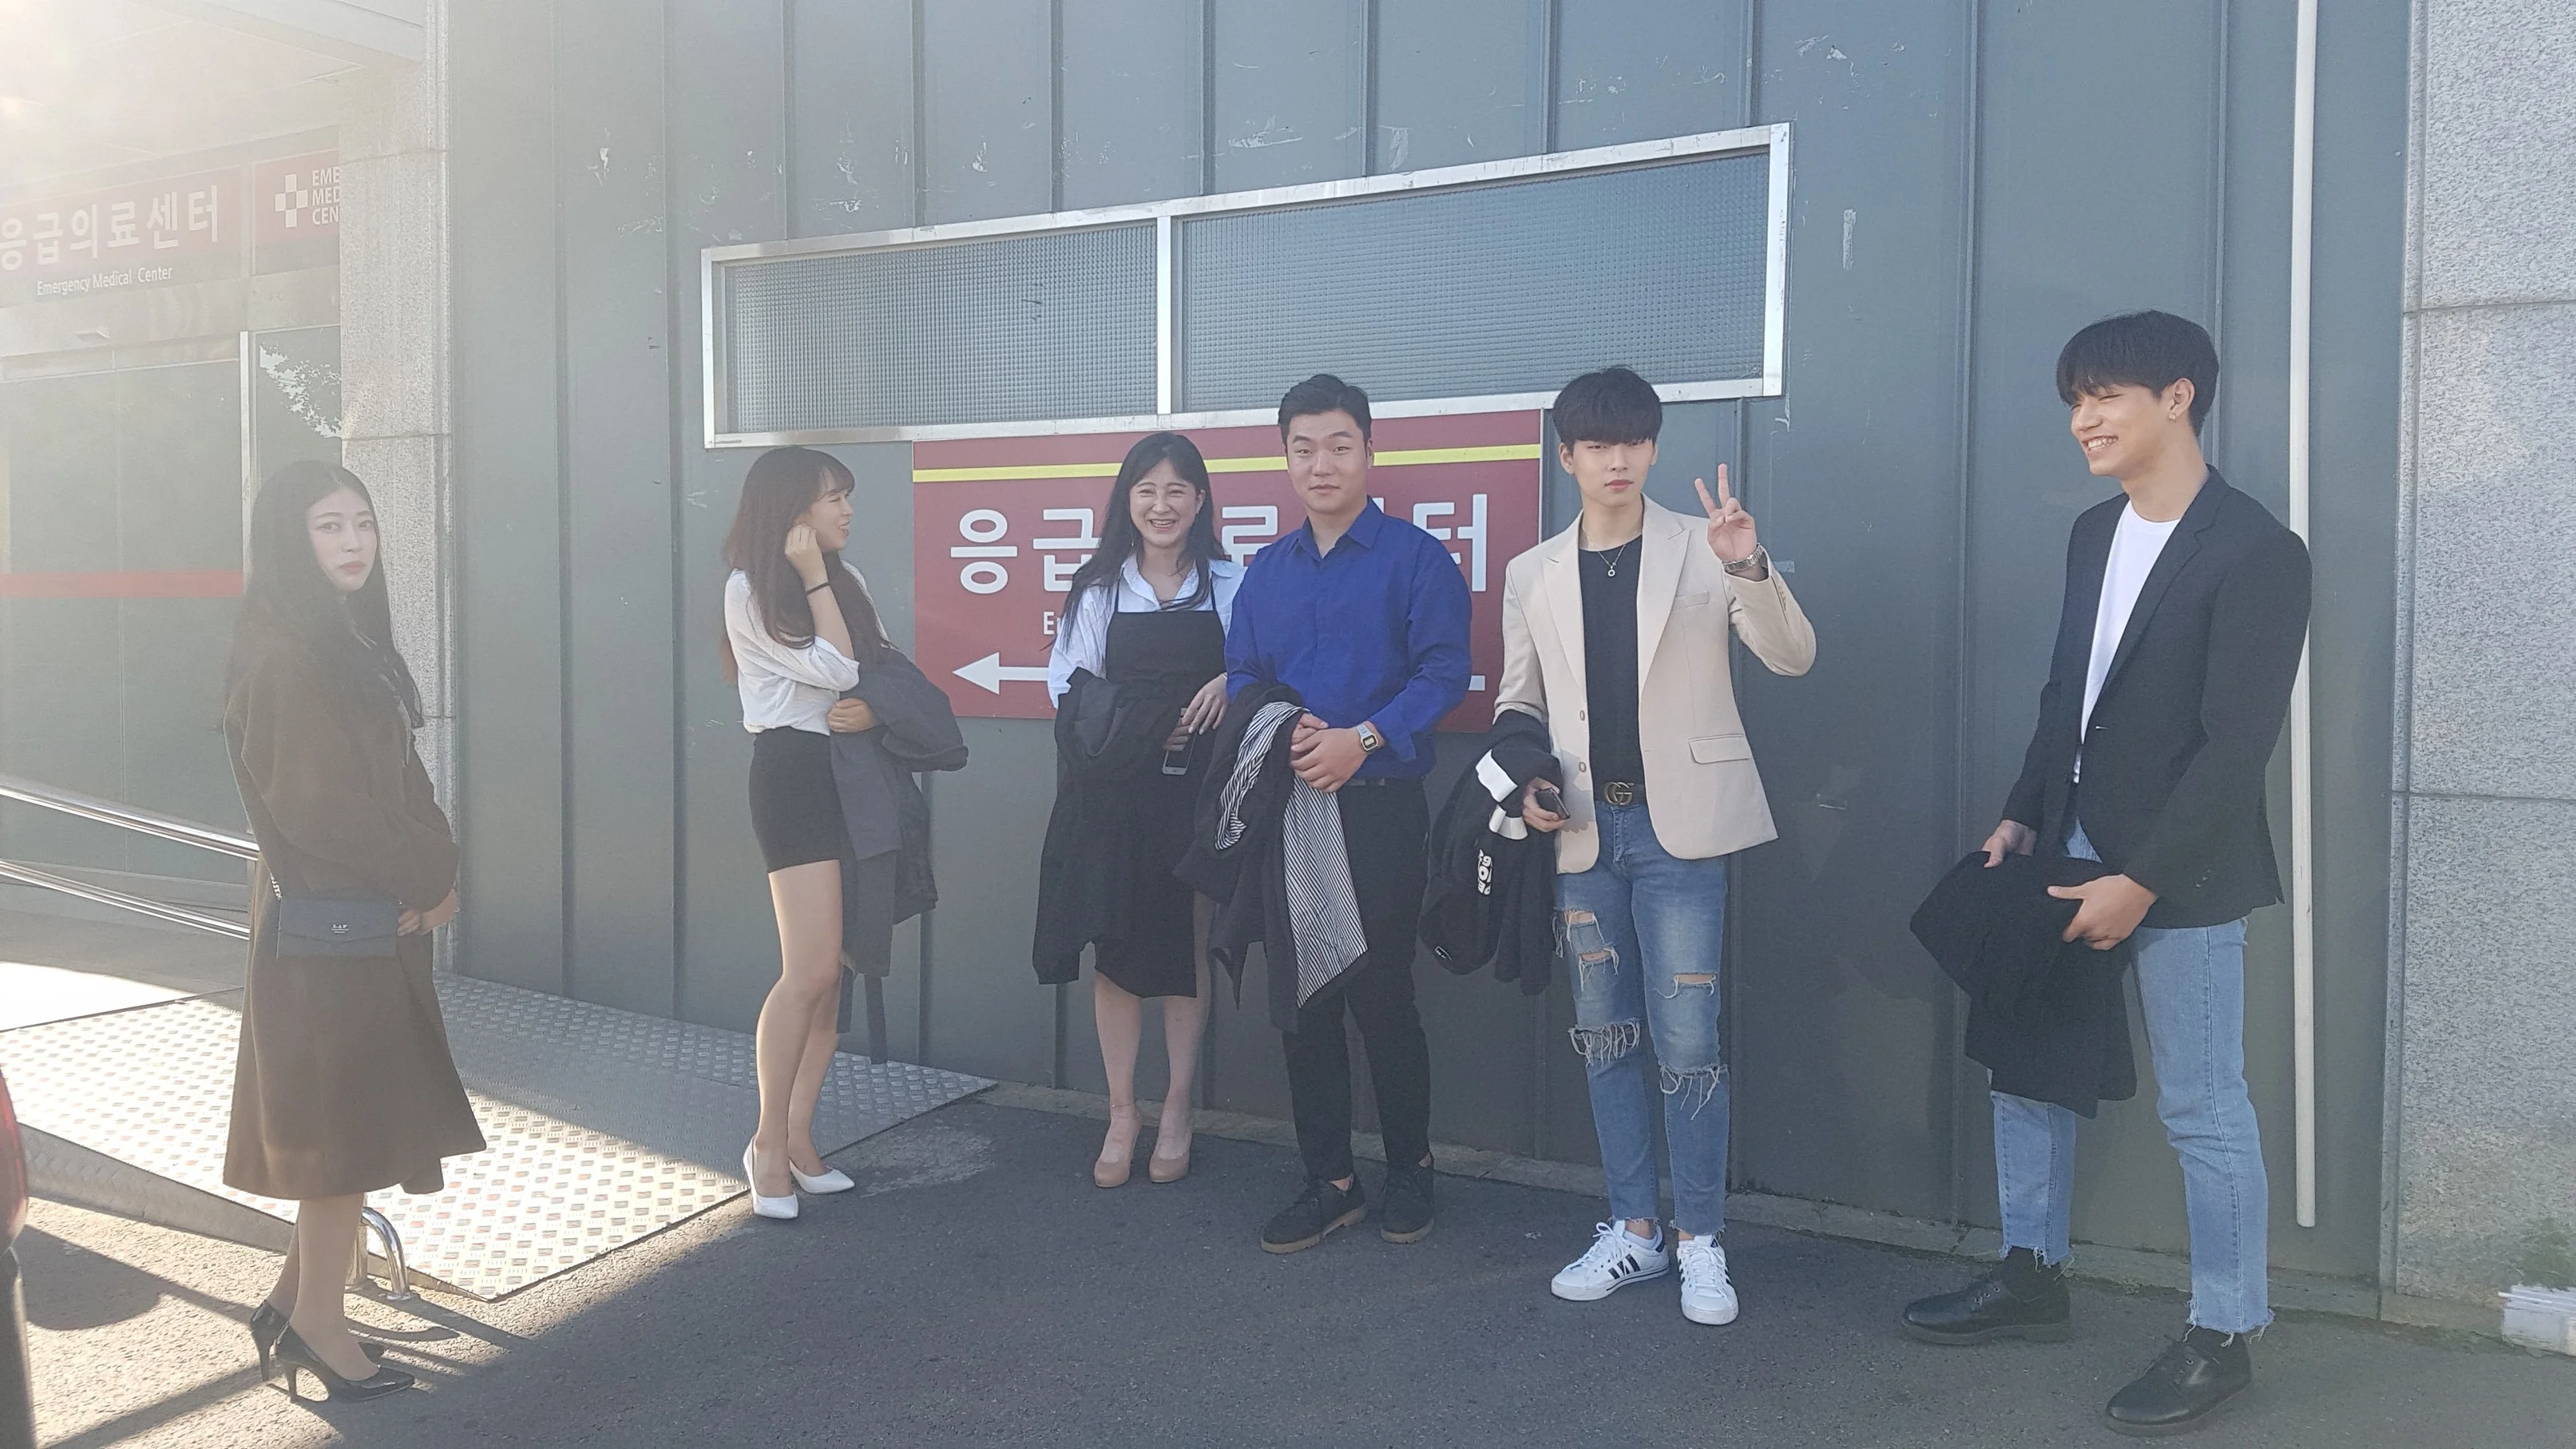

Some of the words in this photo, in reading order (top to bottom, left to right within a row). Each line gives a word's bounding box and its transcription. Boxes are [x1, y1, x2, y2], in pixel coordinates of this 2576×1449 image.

[0, 185, 218, 271] 응급의료센터
[37, 278, 90, 296] Emergency
[93, 268, 132, 288] Medical
[137, 265, 172, 283] Center
